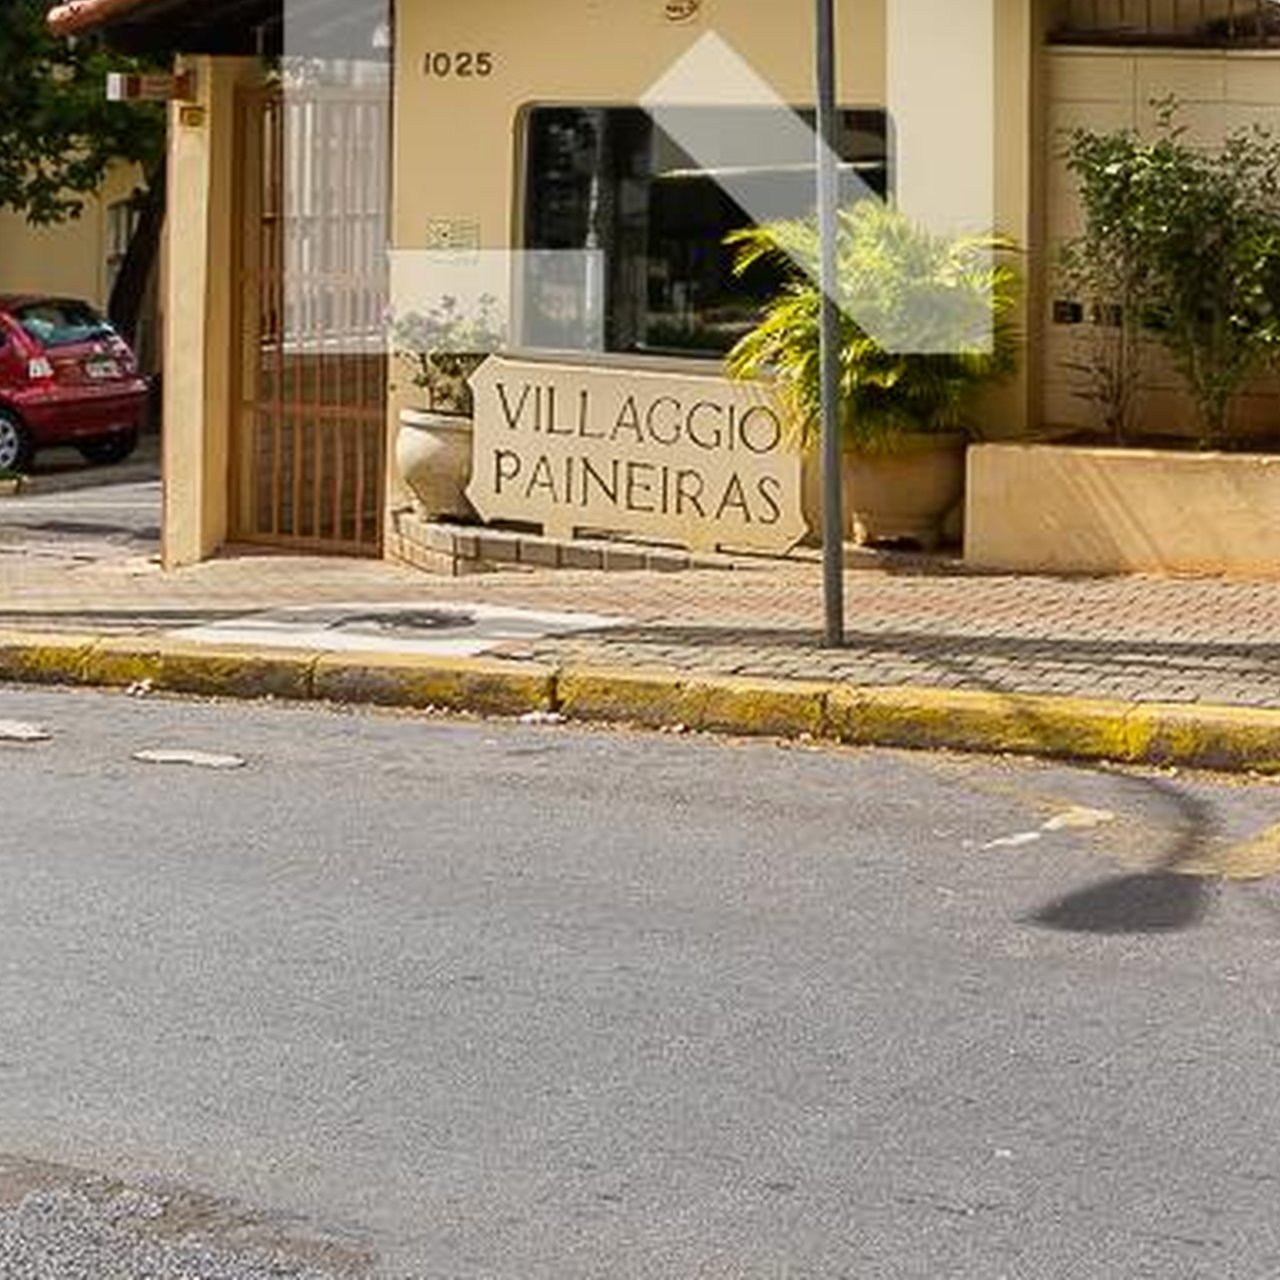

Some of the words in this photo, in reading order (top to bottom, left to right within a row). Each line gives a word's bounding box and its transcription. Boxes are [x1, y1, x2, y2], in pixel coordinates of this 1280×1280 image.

[424, 51, 492, 77] 1025
[495, 382, 782, 454] VILLAGGIO
[493, 448, 782, 525] PAINEIRAS
